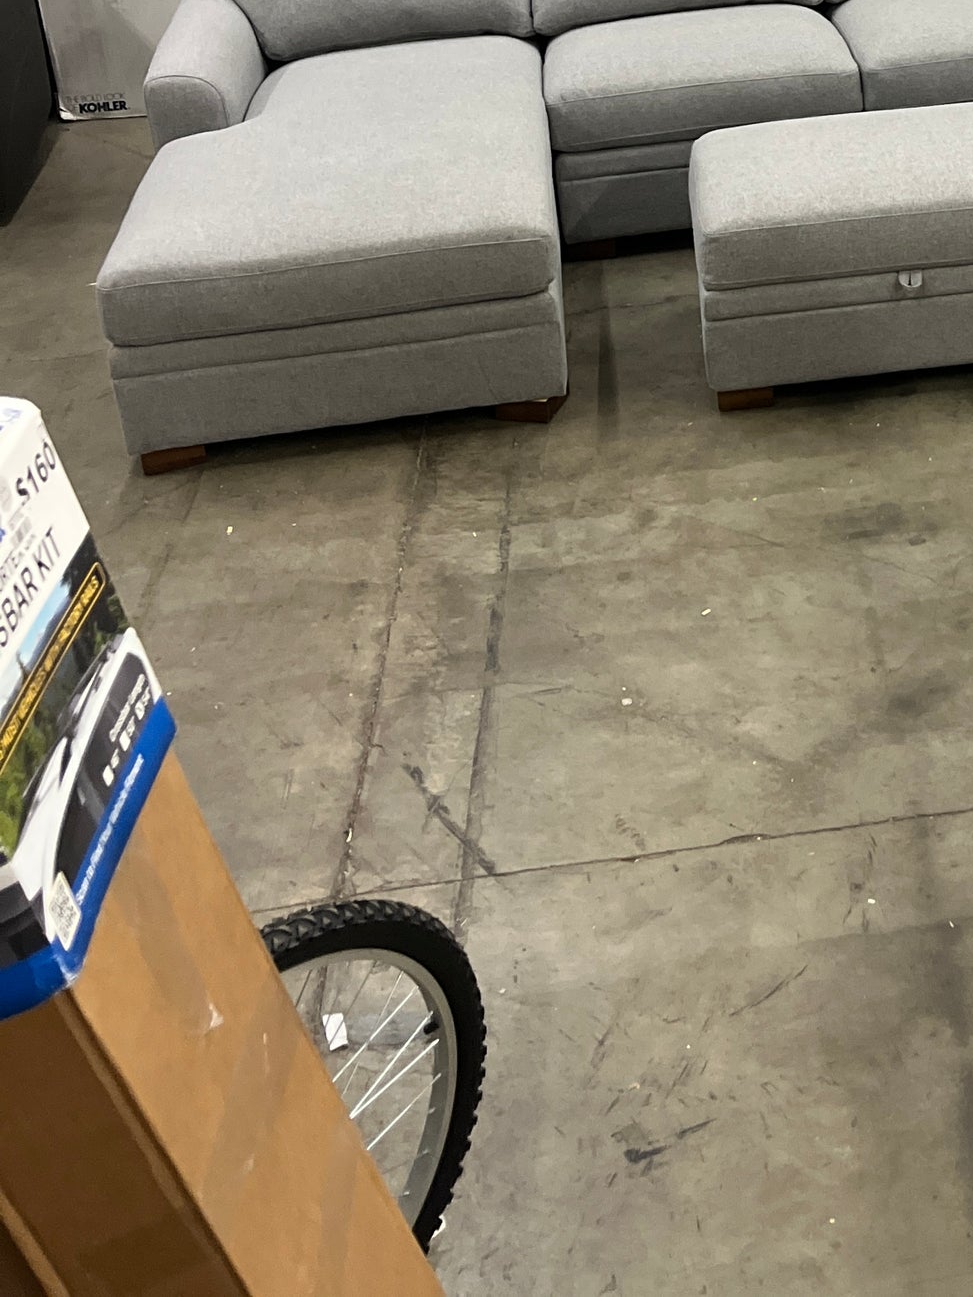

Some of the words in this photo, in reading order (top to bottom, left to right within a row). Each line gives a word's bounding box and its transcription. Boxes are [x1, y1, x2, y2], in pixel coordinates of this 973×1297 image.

[79, 100, 128, 114] KOHLER
[16, 441, 57, 502] $160
[35, 527, 63, 583] KIT
